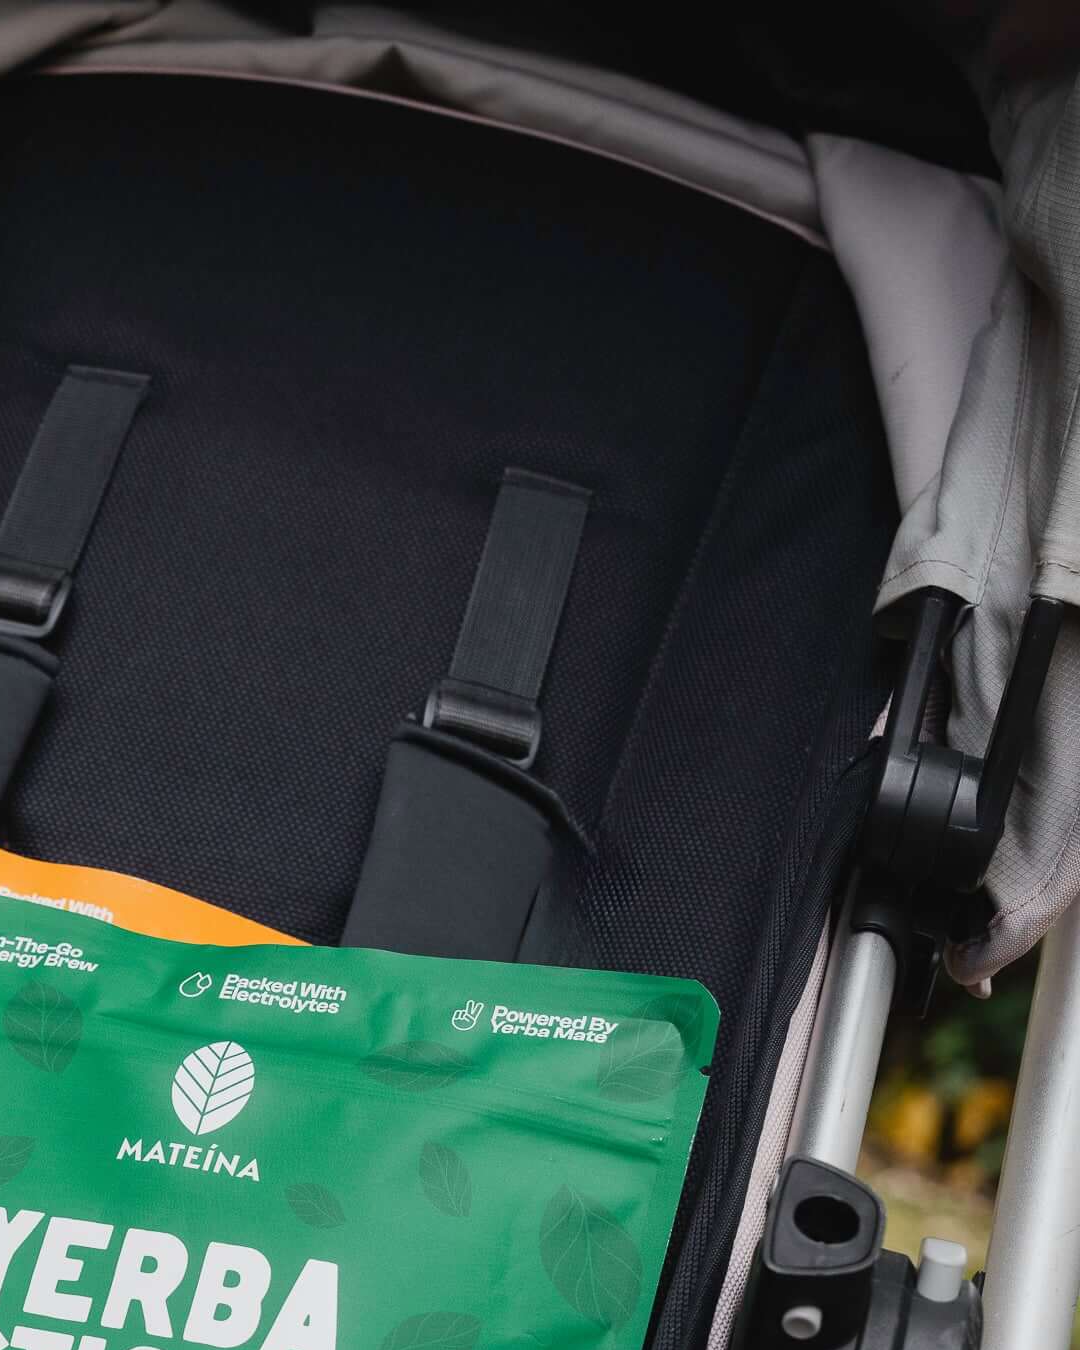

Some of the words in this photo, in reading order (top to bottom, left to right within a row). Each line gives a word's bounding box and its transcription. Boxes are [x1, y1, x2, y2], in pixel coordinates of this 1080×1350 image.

[43, 953, 99, 972] Brew
[218, 985, 340, 1014] Electrolytes
[223, 973, 298, 996] Packed
[300, 982, 347, 1001] With
[491, 1005, 588, 1031] Powered
[589, 1017, 619, 1035] By
[491, 1020, 550, 1037] Yerba
[553, 1027, 609, 1044] Mate
[116, 1136, 260, 1182] MATEÍNA
